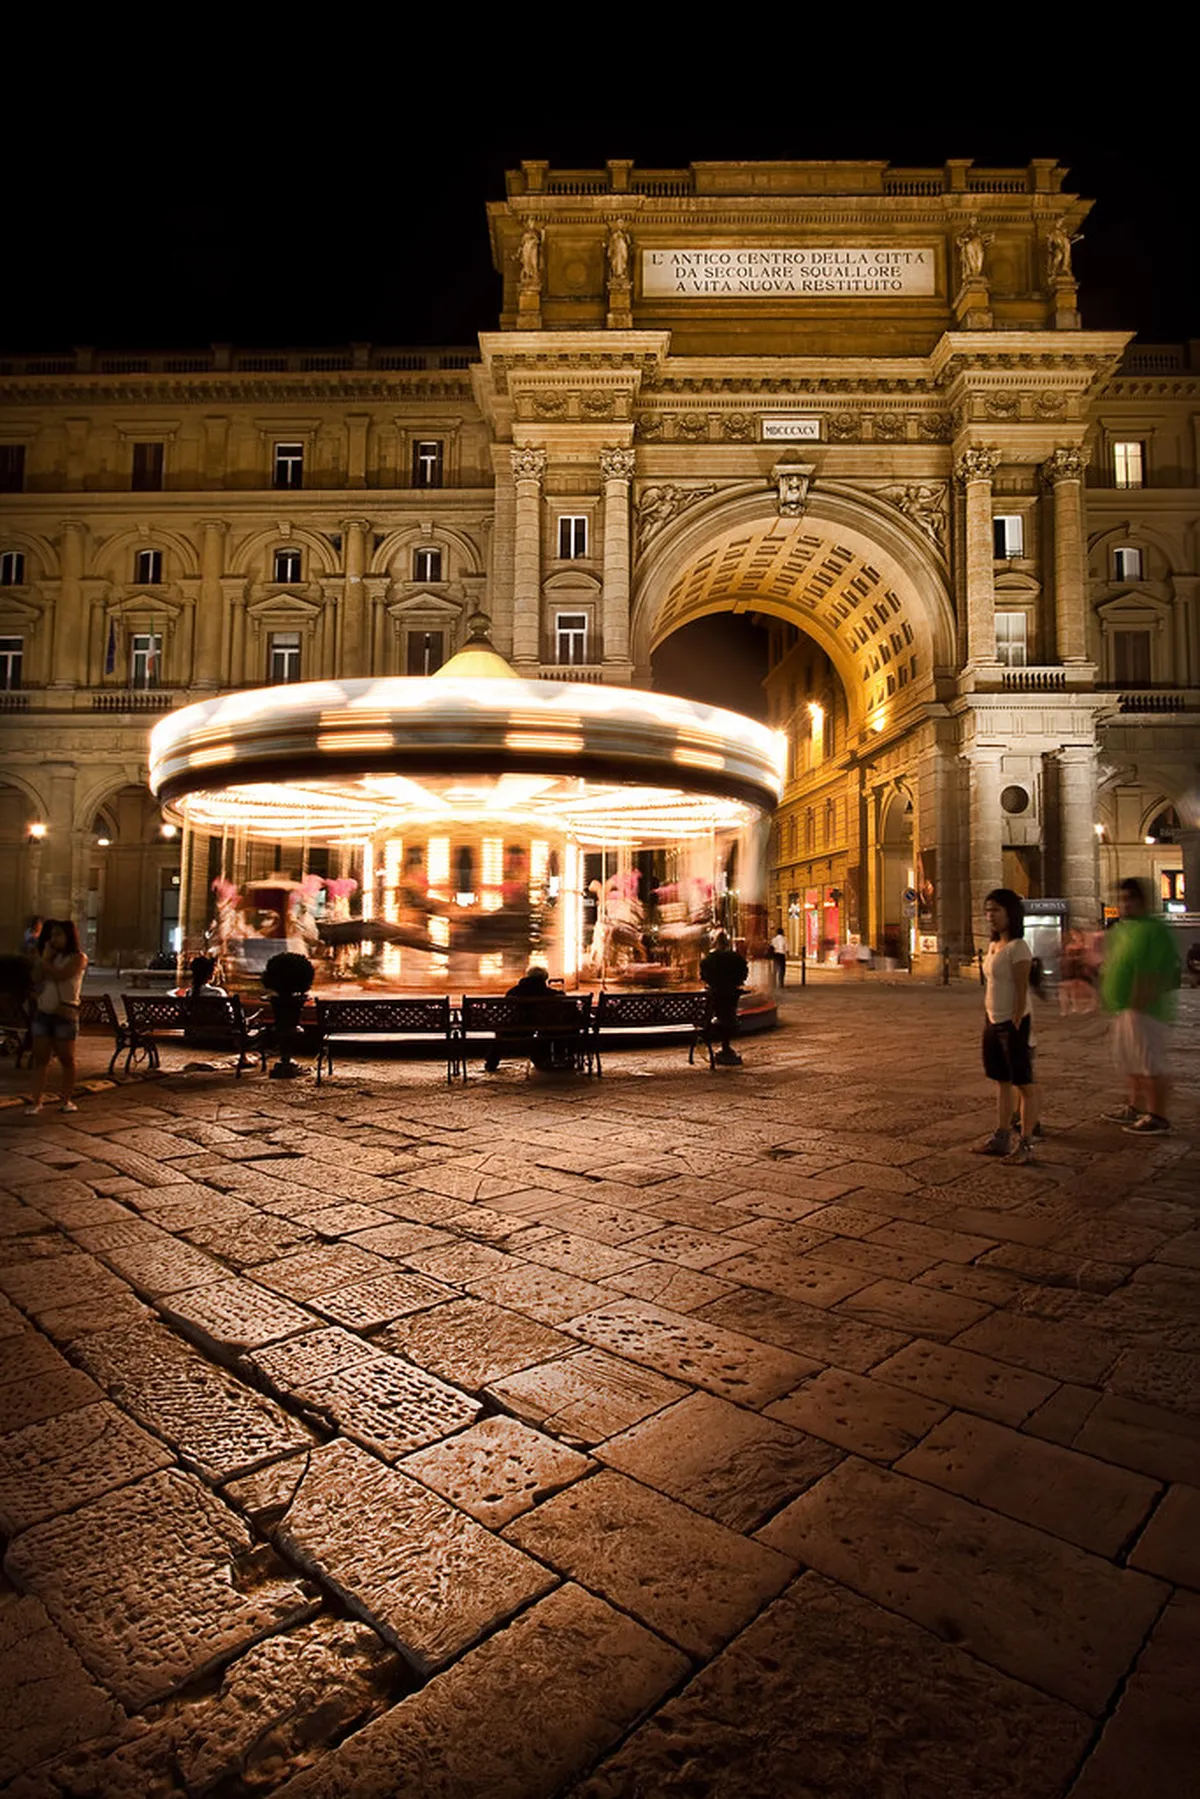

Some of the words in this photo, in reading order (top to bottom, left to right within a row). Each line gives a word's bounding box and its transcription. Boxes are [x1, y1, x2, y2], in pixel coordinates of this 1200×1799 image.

[670, 253, 731, 265] ANTICO
[737, 253, 805, 265] CENTRO
[811, 253, 868, 264] DELLA
[676, 267, 697, 278] DA
[704, 266, 793, 278] SECOLARE
[800, 266, 902, 278] SQUALLORE
[675, 280, 686, 292] A
[693, 280, 731, 292] VITA
[739, 280, 796, 292] NUOVA
[802, 279, 902, 291] RESTITUITO
